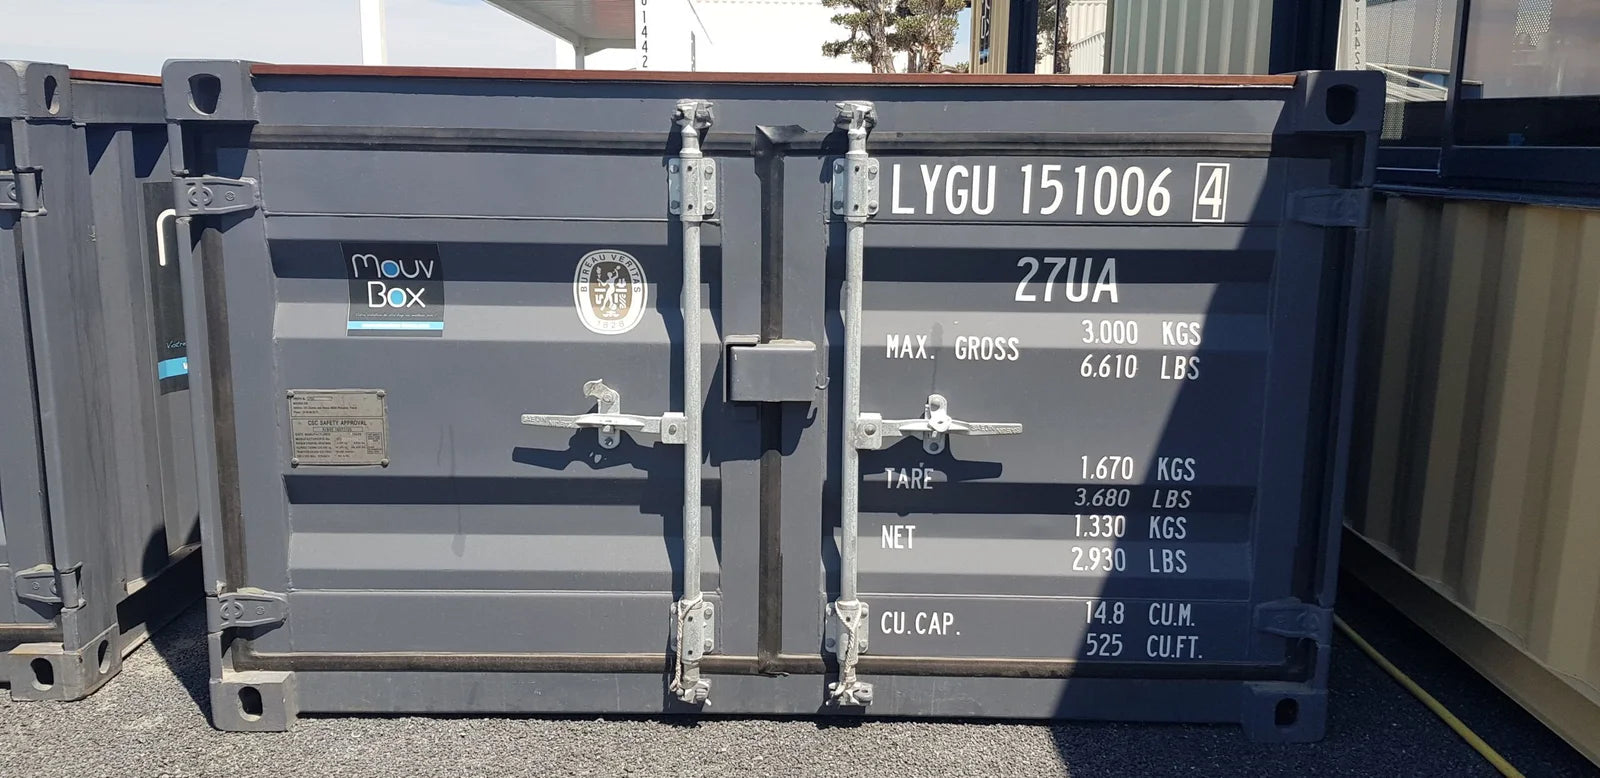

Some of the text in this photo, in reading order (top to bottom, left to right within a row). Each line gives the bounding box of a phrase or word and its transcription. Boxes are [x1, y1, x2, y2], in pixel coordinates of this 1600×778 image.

[891, 163, 1225, 220] LYGU 151006 4
[580, 253, 642, 293] BUREAU VERITAS
[1014, 256, 1120, 303] 27UA
[367, 280, 427, 308] Box
[1161, 320, 1202, 347] KGS
[885, 333, 1020, 362] MAX. GROSS
[1159, 355, 1201, 381] LBS
[884, 466, 935, 491] TARE
[1156, 457, 1197, 482] KGS
[1151, 489, 1193, 510] LBS
[880, 524, 917, 551] NET
[1148, 515, 1188, 540] KGS
[1149, 548, 1189, 574] LBS
[1085, 600, 1196, 628] 14.8 CU.M.
[1086, 632, 1203, 660] 525 CU.FT.
